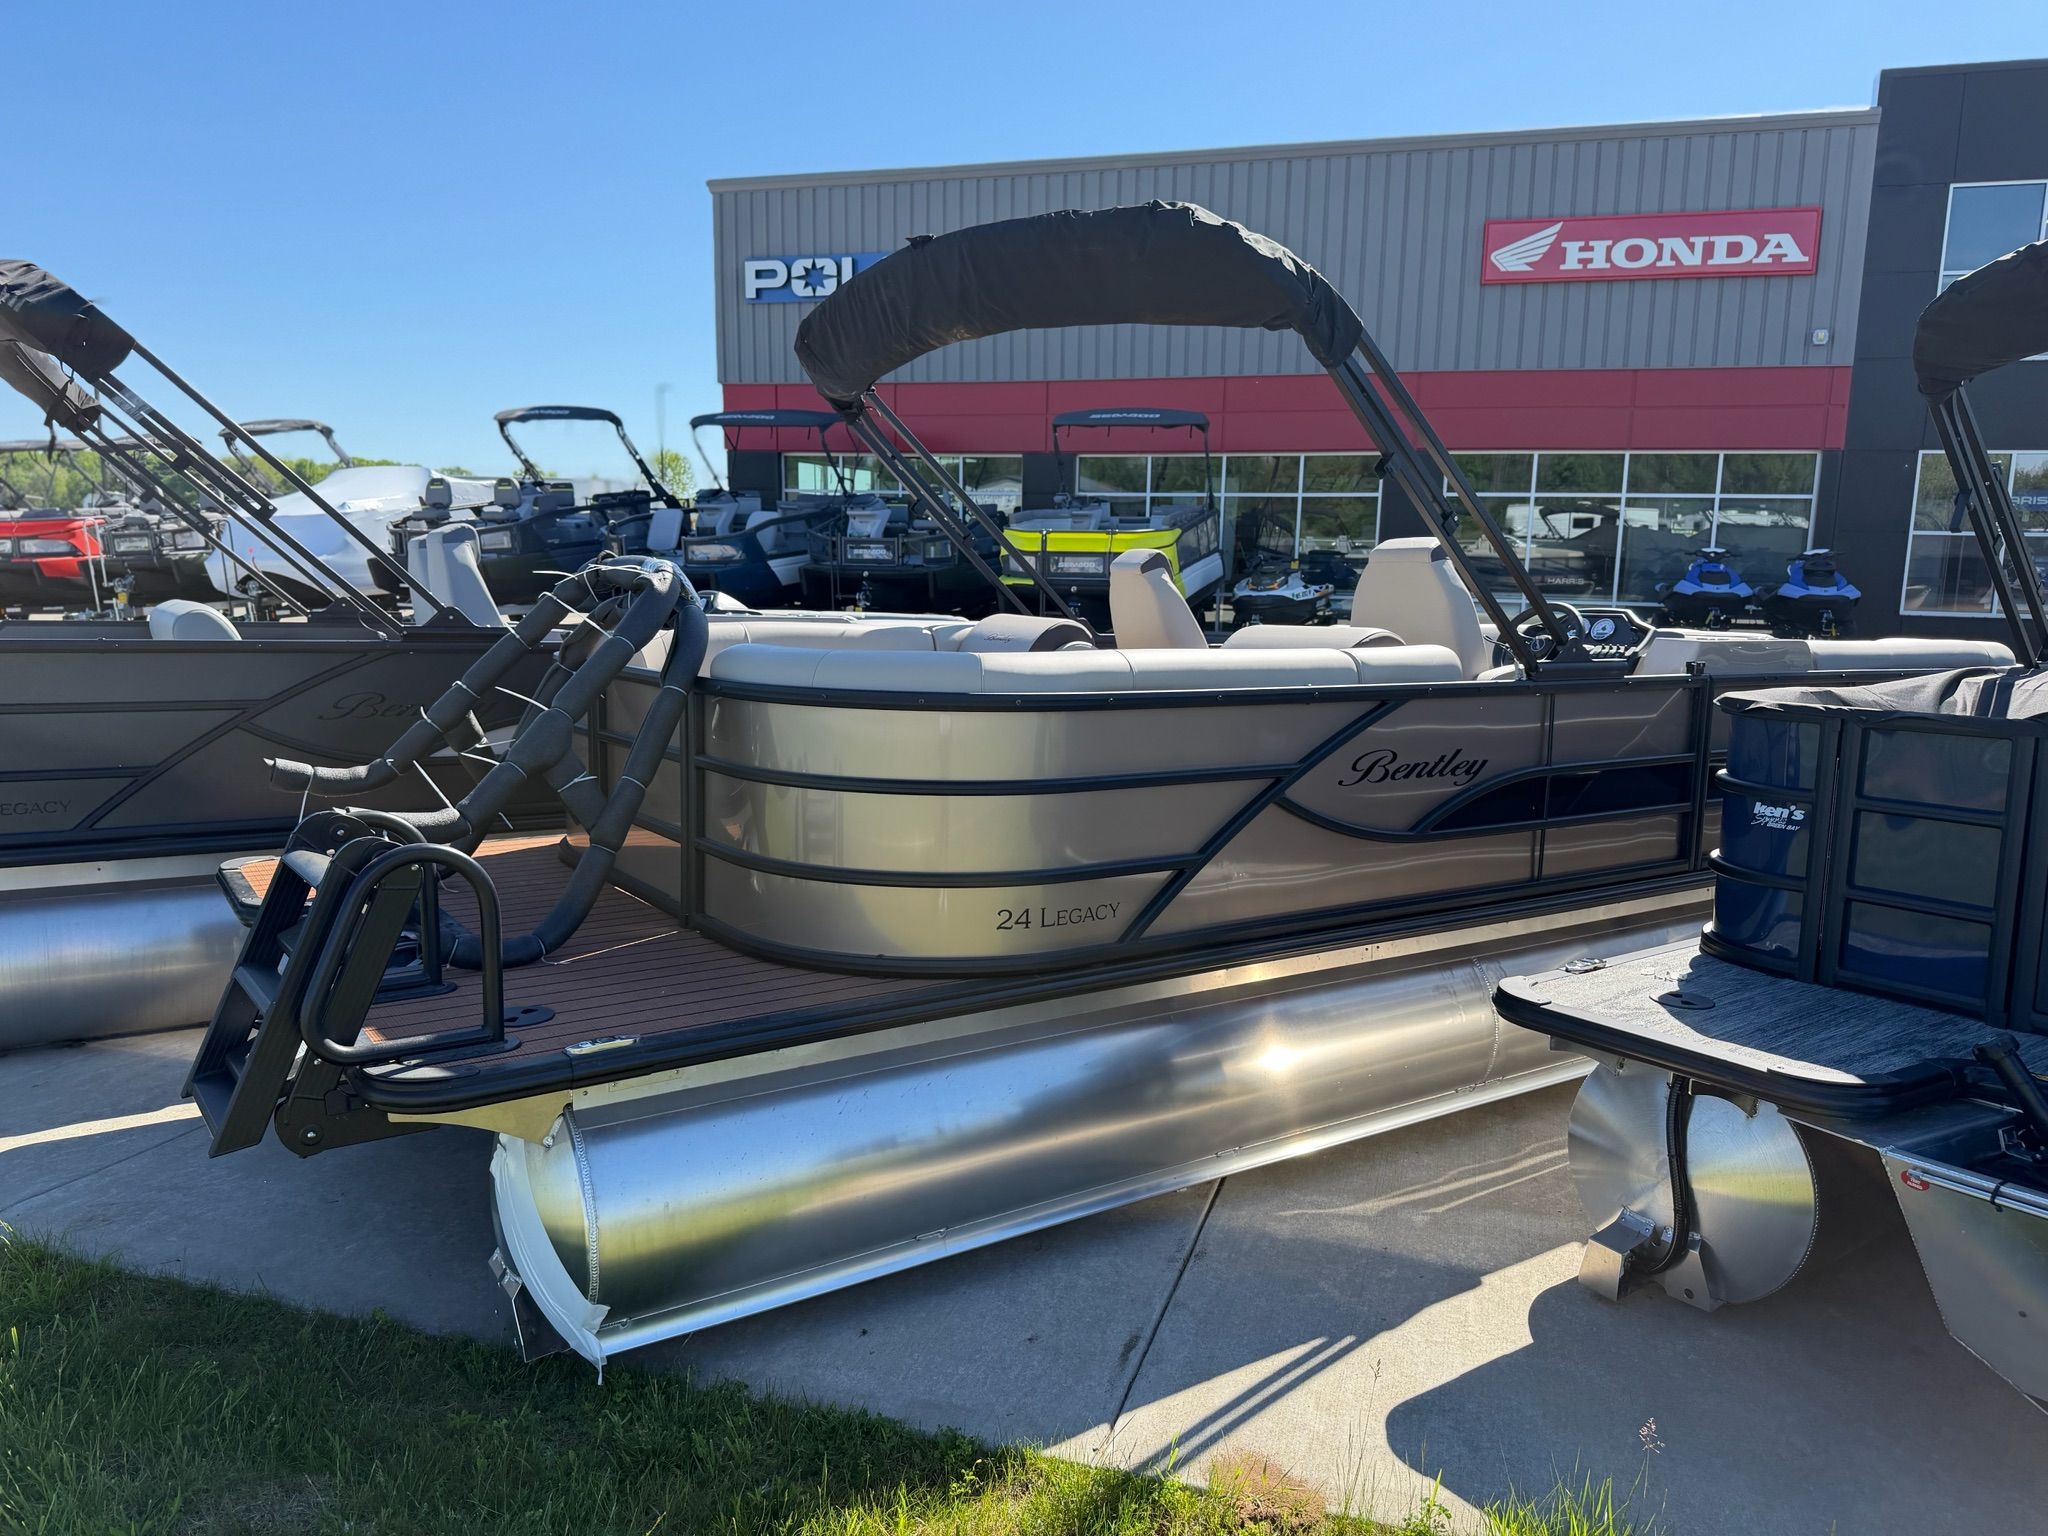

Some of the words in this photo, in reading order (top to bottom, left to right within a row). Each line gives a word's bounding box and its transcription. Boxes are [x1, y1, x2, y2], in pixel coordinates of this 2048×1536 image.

[1559, 233, 1809, 270] HONDA
[1337, 748, 1489, 787] Bentley
[996, 908, 1032, 931] 24
